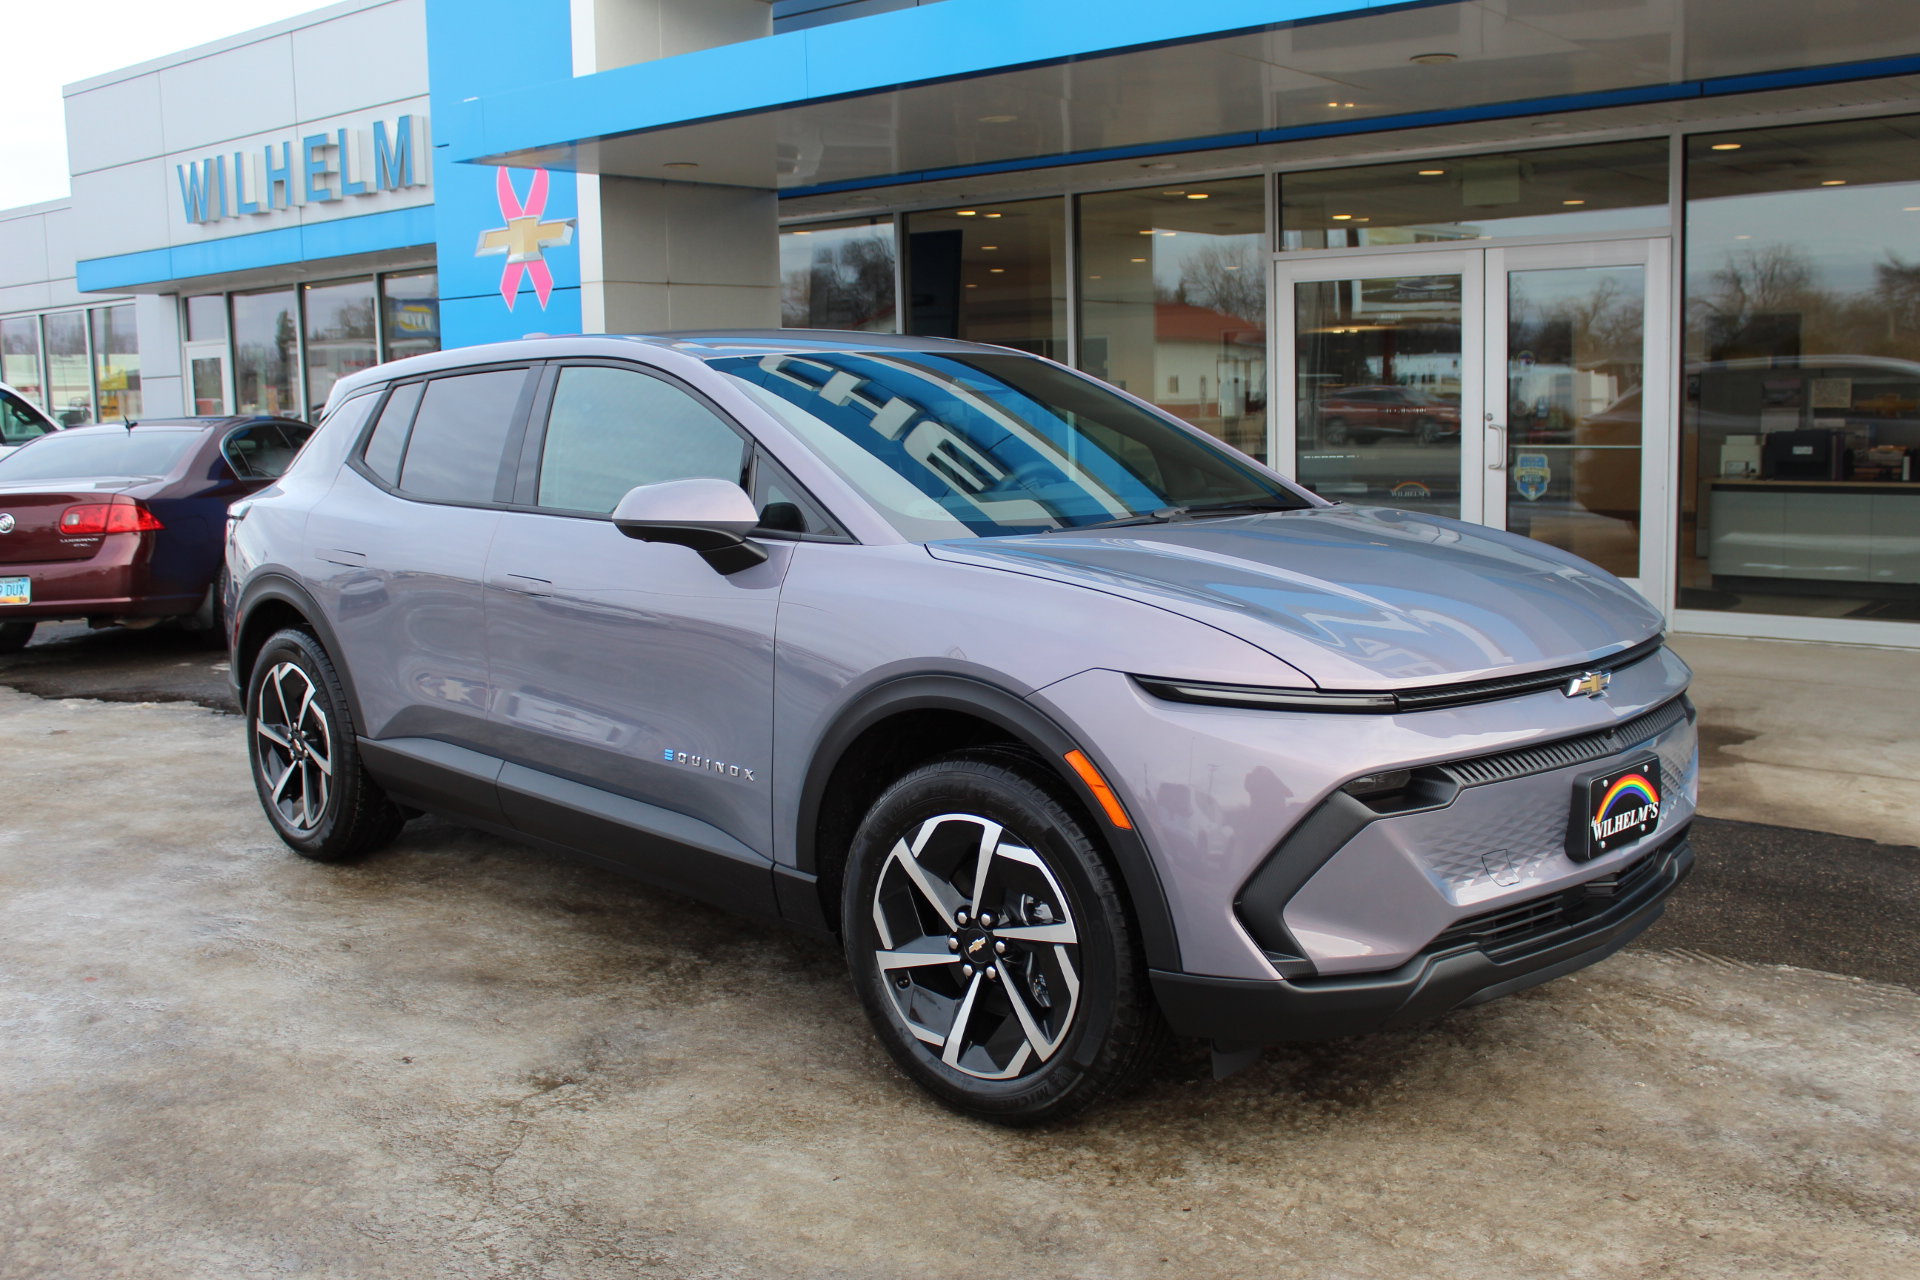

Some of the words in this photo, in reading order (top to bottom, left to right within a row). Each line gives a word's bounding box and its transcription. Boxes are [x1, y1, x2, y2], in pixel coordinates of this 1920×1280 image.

[177, 114, 426, 225] WILHELM
[664, 748, 755, 782] EQUINOX
[1591, 801, 1660, 842] WILHELM'S
